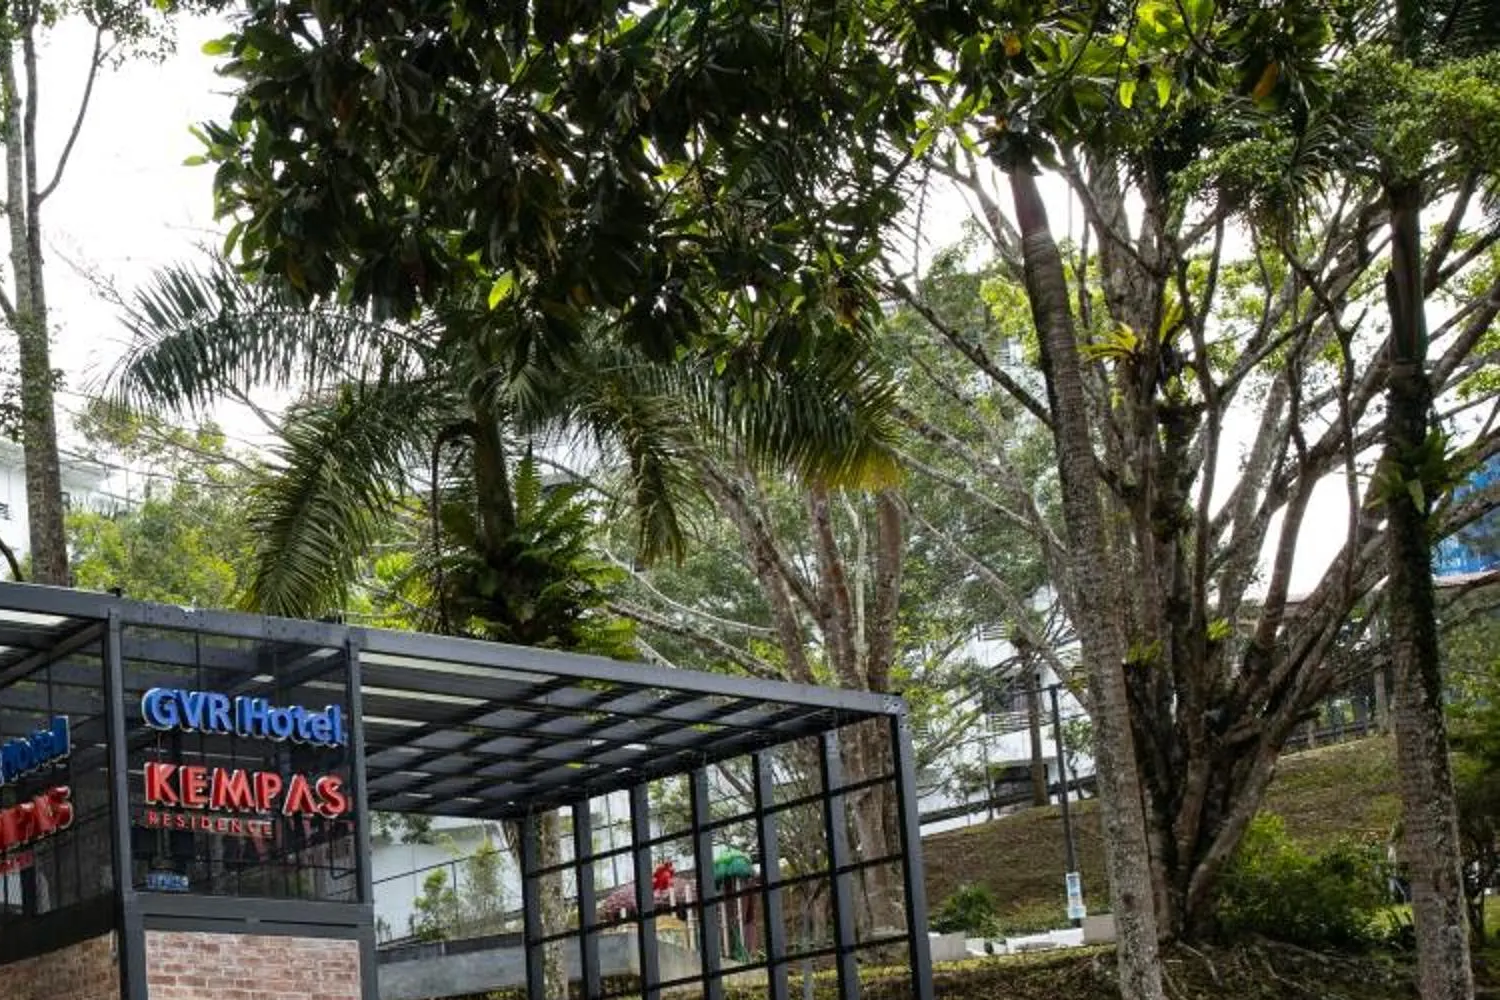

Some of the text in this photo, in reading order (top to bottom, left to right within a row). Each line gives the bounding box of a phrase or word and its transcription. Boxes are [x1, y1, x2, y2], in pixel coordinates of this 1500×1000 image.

[142, 687, 343, 748] GVR Hotel
[143, 762, 349, 819] KEMPAS
[148, 810, 274, 838] RESIDENCE
